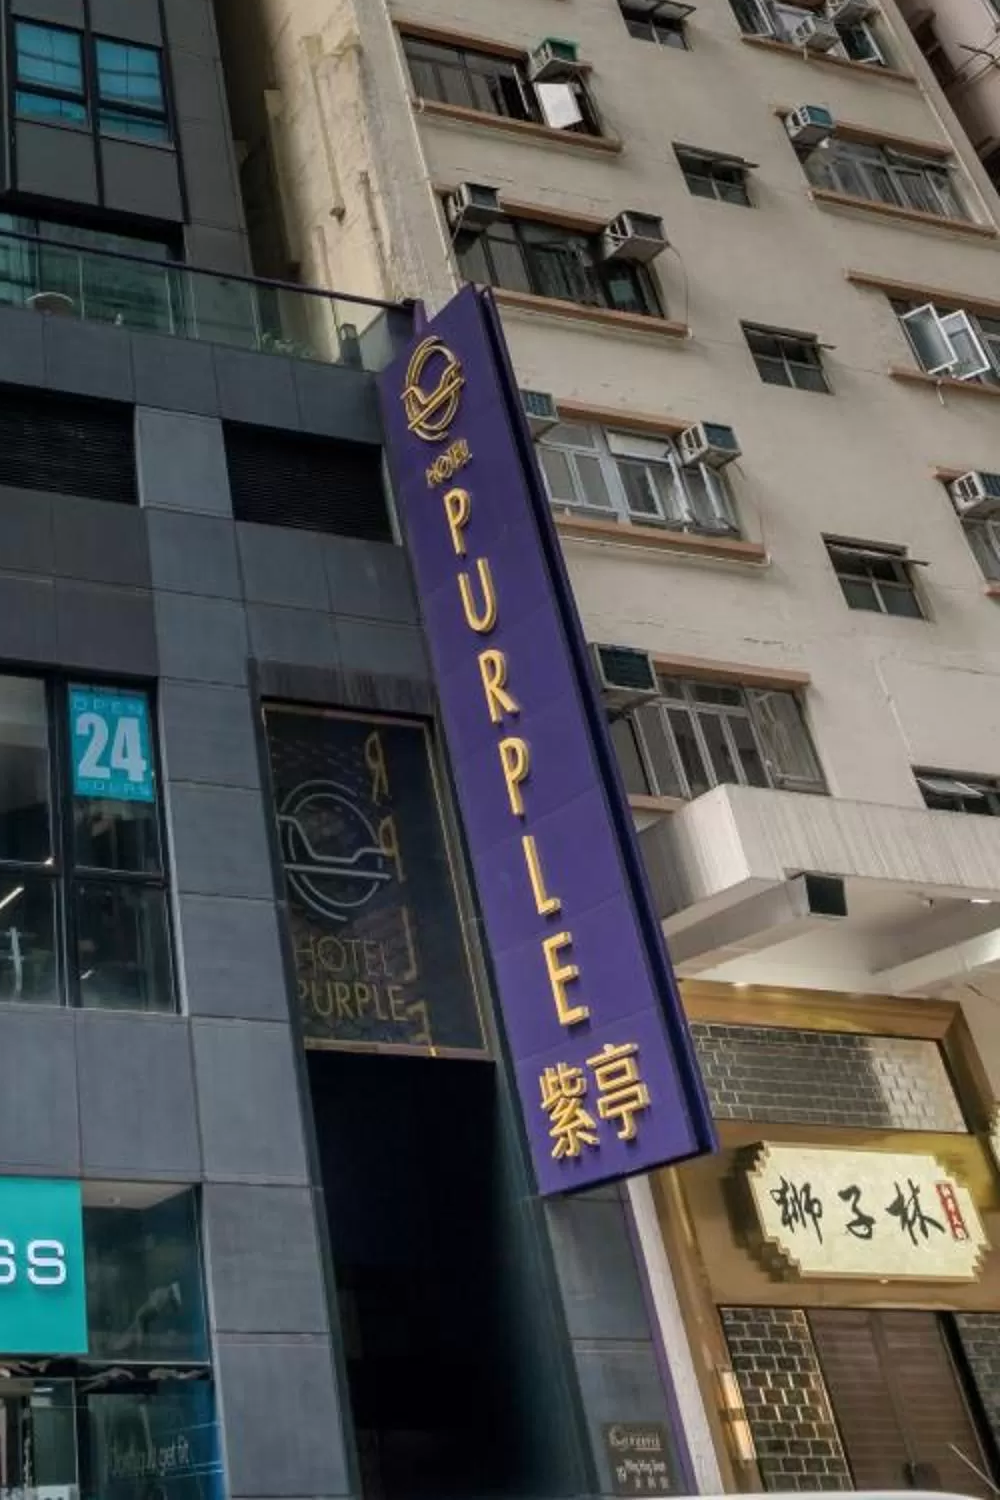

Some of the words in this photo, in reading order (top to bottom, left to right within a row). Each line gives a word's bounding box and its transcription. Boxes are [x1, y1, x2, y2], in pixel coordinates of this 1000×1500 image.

[75, 711, 148, 783] 24
[443, 487, 590, 1027] PURPLE
[294, 934, 393, 979] HOTEL
[540, 1043, 652, 1159] 紫亭
